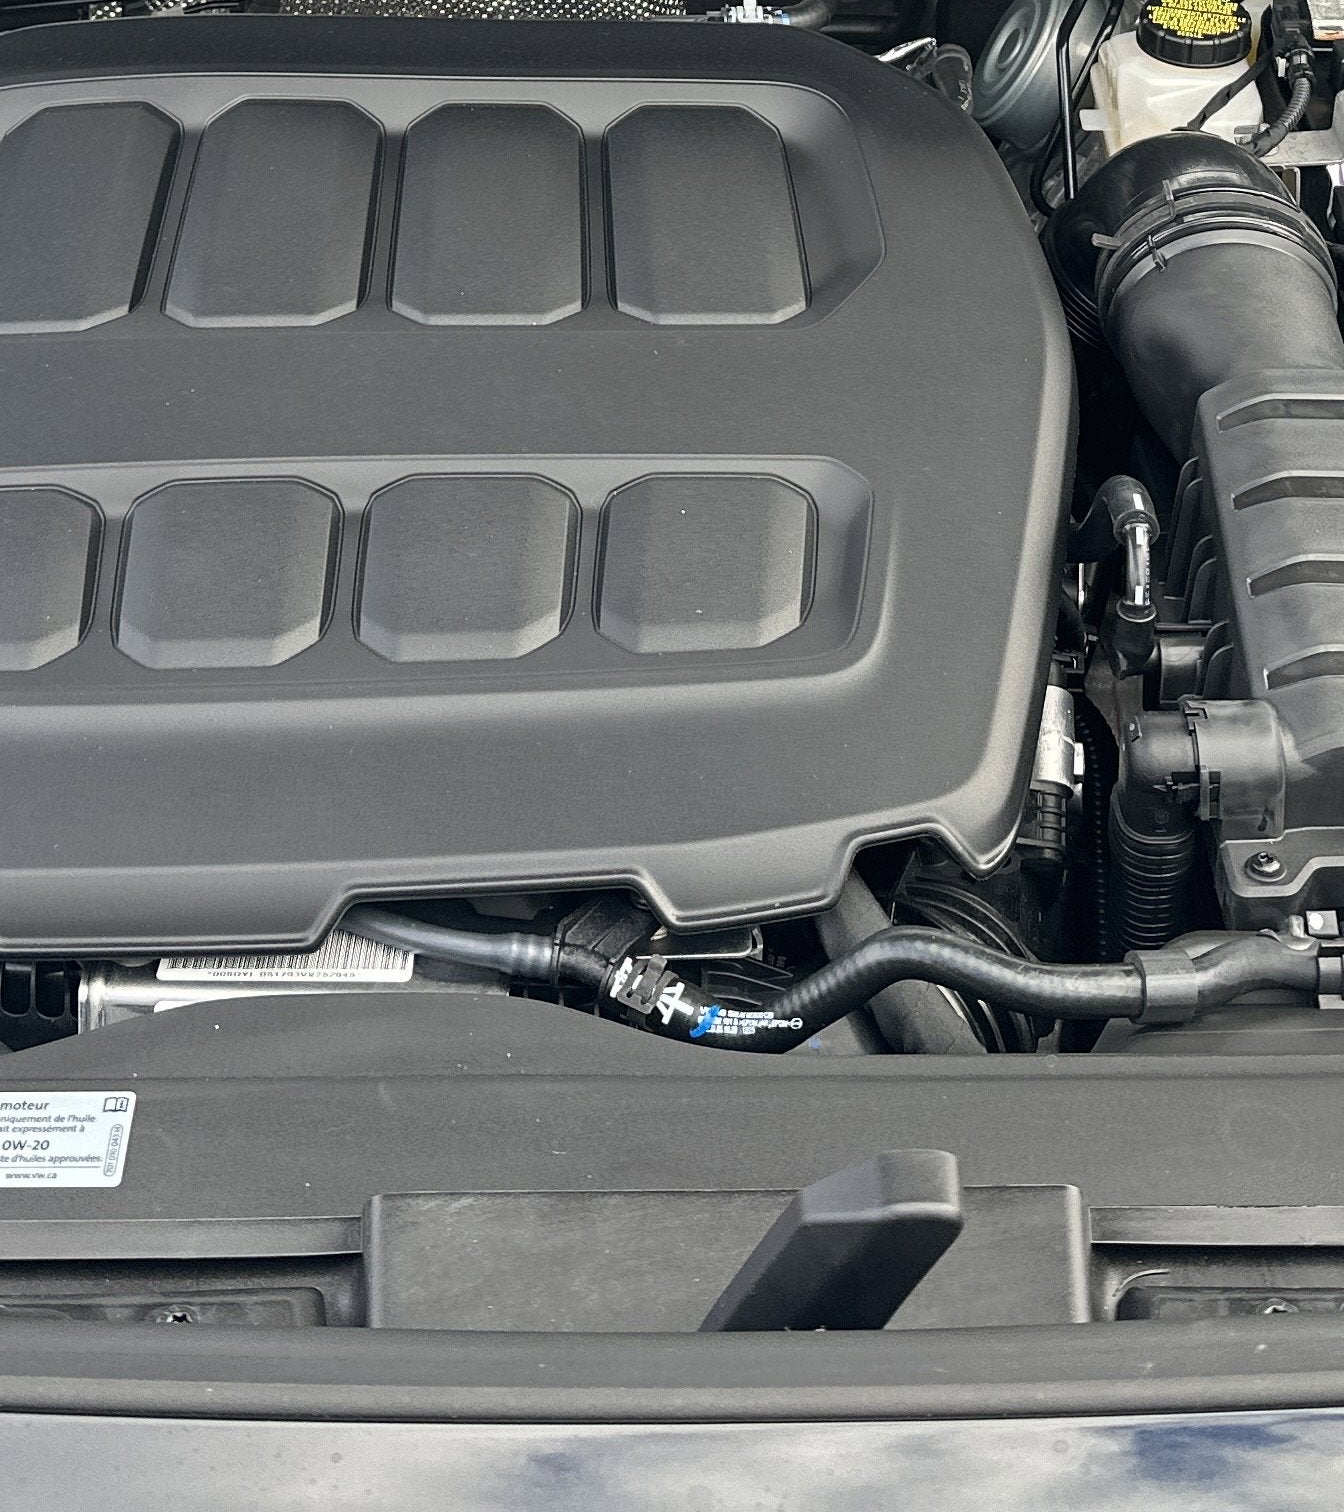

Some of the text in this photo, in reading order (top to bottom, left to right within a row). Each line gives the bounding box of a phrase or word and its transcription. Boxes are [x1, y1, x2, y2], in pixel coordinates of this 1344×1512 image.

[0, 1101, 50, 1111] moteur
[53, 1115, 66, 1123] de
[67, 1114, 96, 1123] l'huile
[11, 1125, 78, 1134] expressément
[2, 1140, 51, 1151] 0W-20
[11, 1154, 46, 1163] d'huiles
